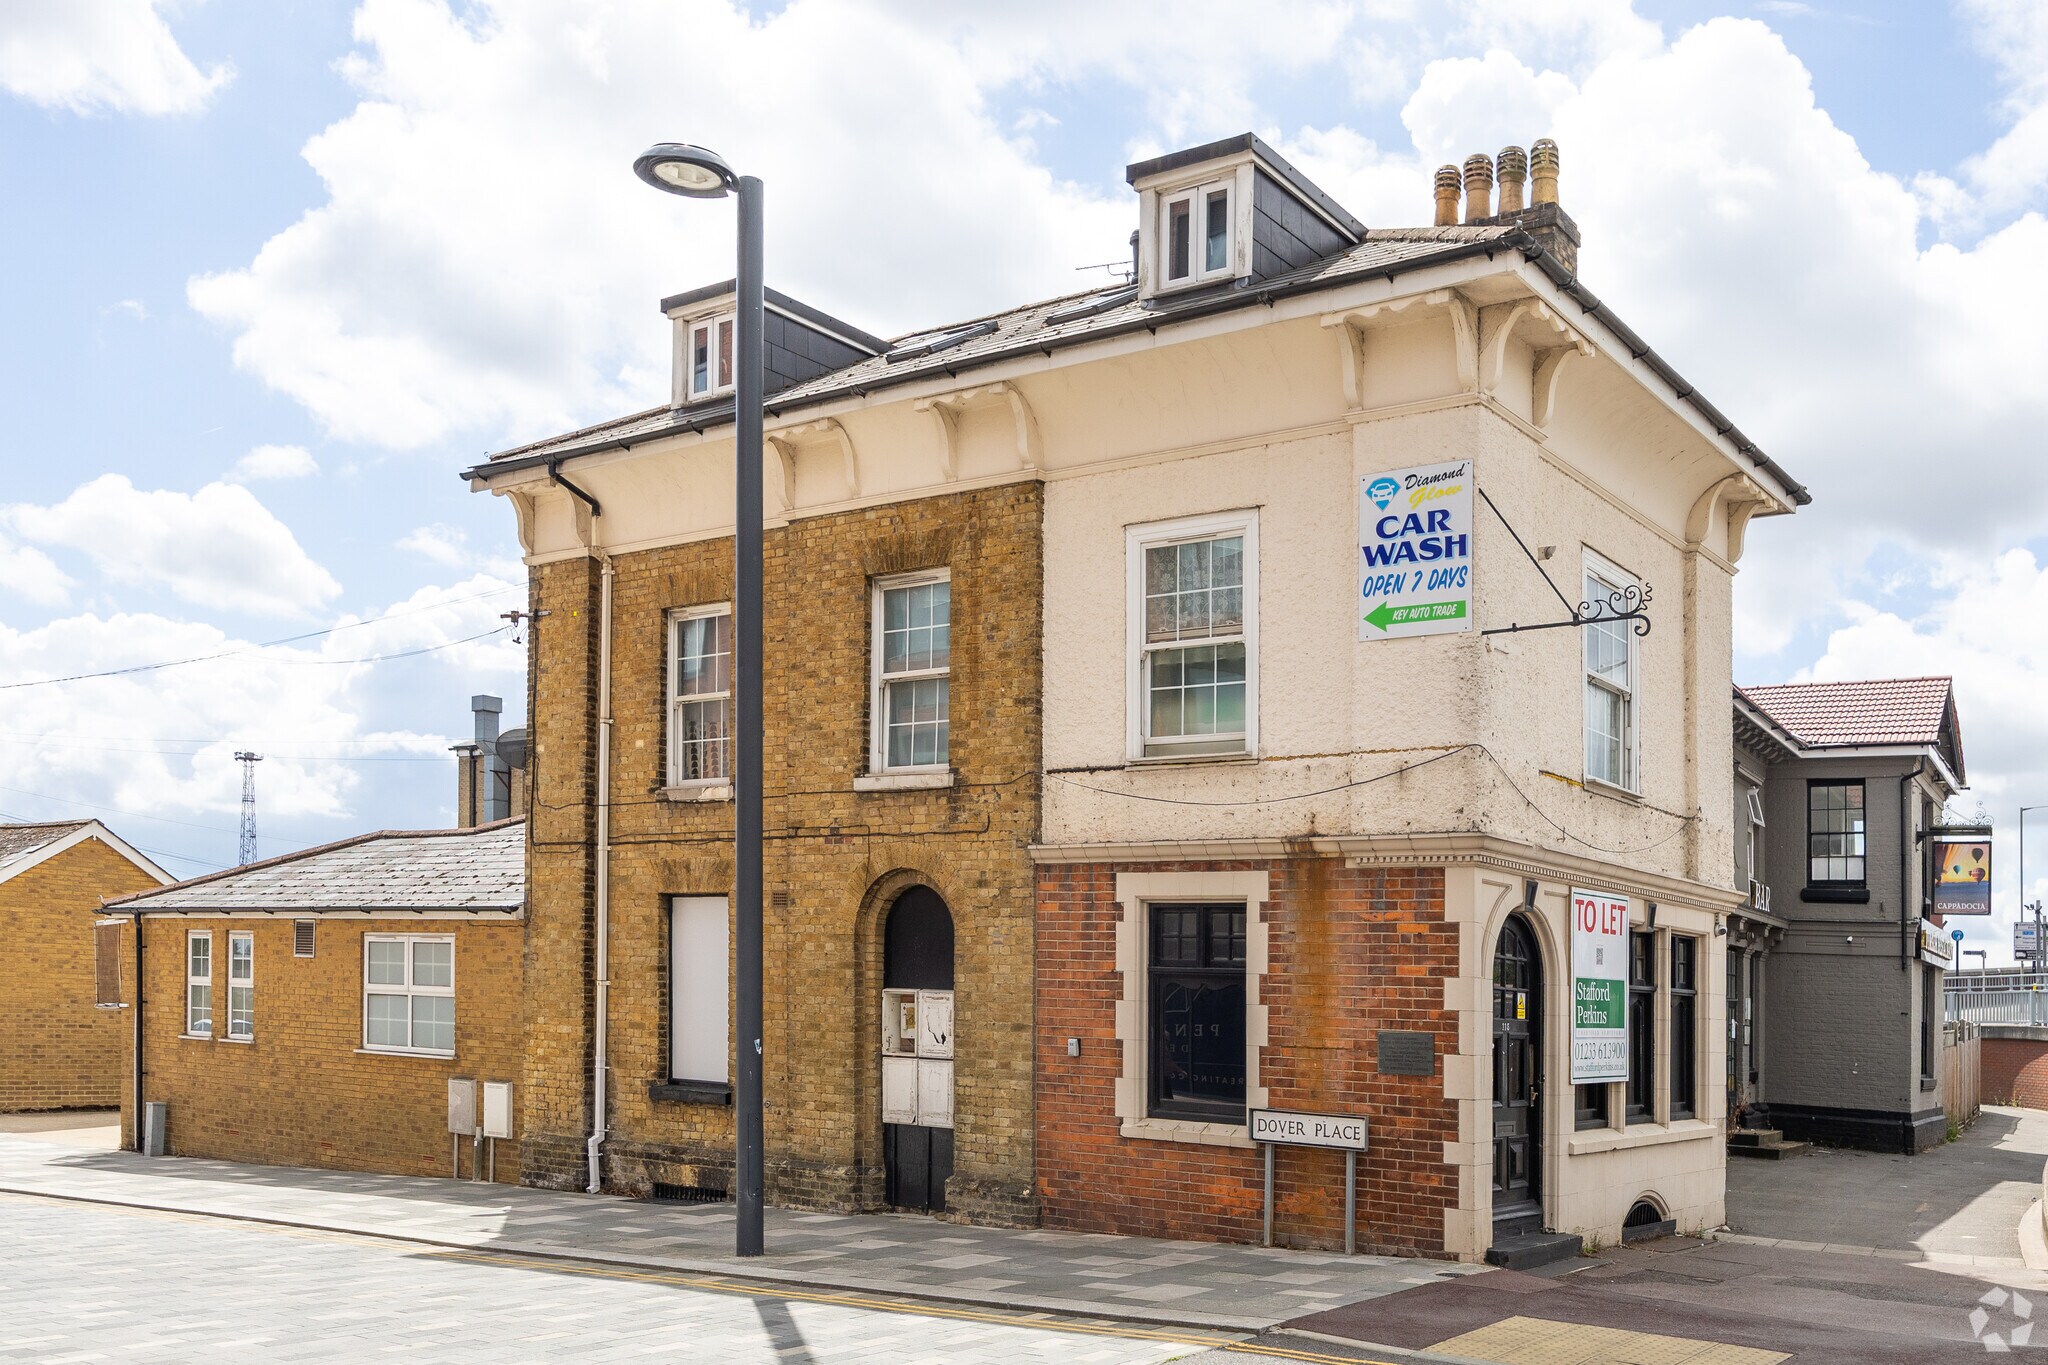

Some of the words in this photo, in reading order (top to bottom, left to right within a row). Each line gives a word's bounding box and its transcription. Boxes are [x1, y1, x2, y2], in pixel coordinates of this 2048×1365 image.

[1404, 463, 1465, 490] Diamond
[1409, 485, 1463, 509] Glow
[1376, 508, 1453, 540] CAR
[1362, 534, 1468, 568] WASH
[1363, 572, 1407, 598] OPEN
[1411, 570, 1424, 593] 7
[1427, 565, 1469, 591] DAYS
[1392, 608, 1408, 621] KEY
[1408, 606, 1431, 619] AUTO
[1432, 603, 1458, 617] TRADE
[1755, 882, 1771, 912] BAR
[1937, 902, 1986, 910] CAPPADOCIA
[1575, 899, 1597, 933] TO
[1601, 902, 1626, 936] LET
[1577, 981, 1610, 1003] Stafford
[1577, 1004, 1608, 1025] Perkins
[1575, 1042, 1597, 1060] 01233
[1598, 1042, 1626, 1060] 613900
[1257, 1118, 1306, 1136] DOVER
[1314, 1122, 1361, 1141] PLACE
